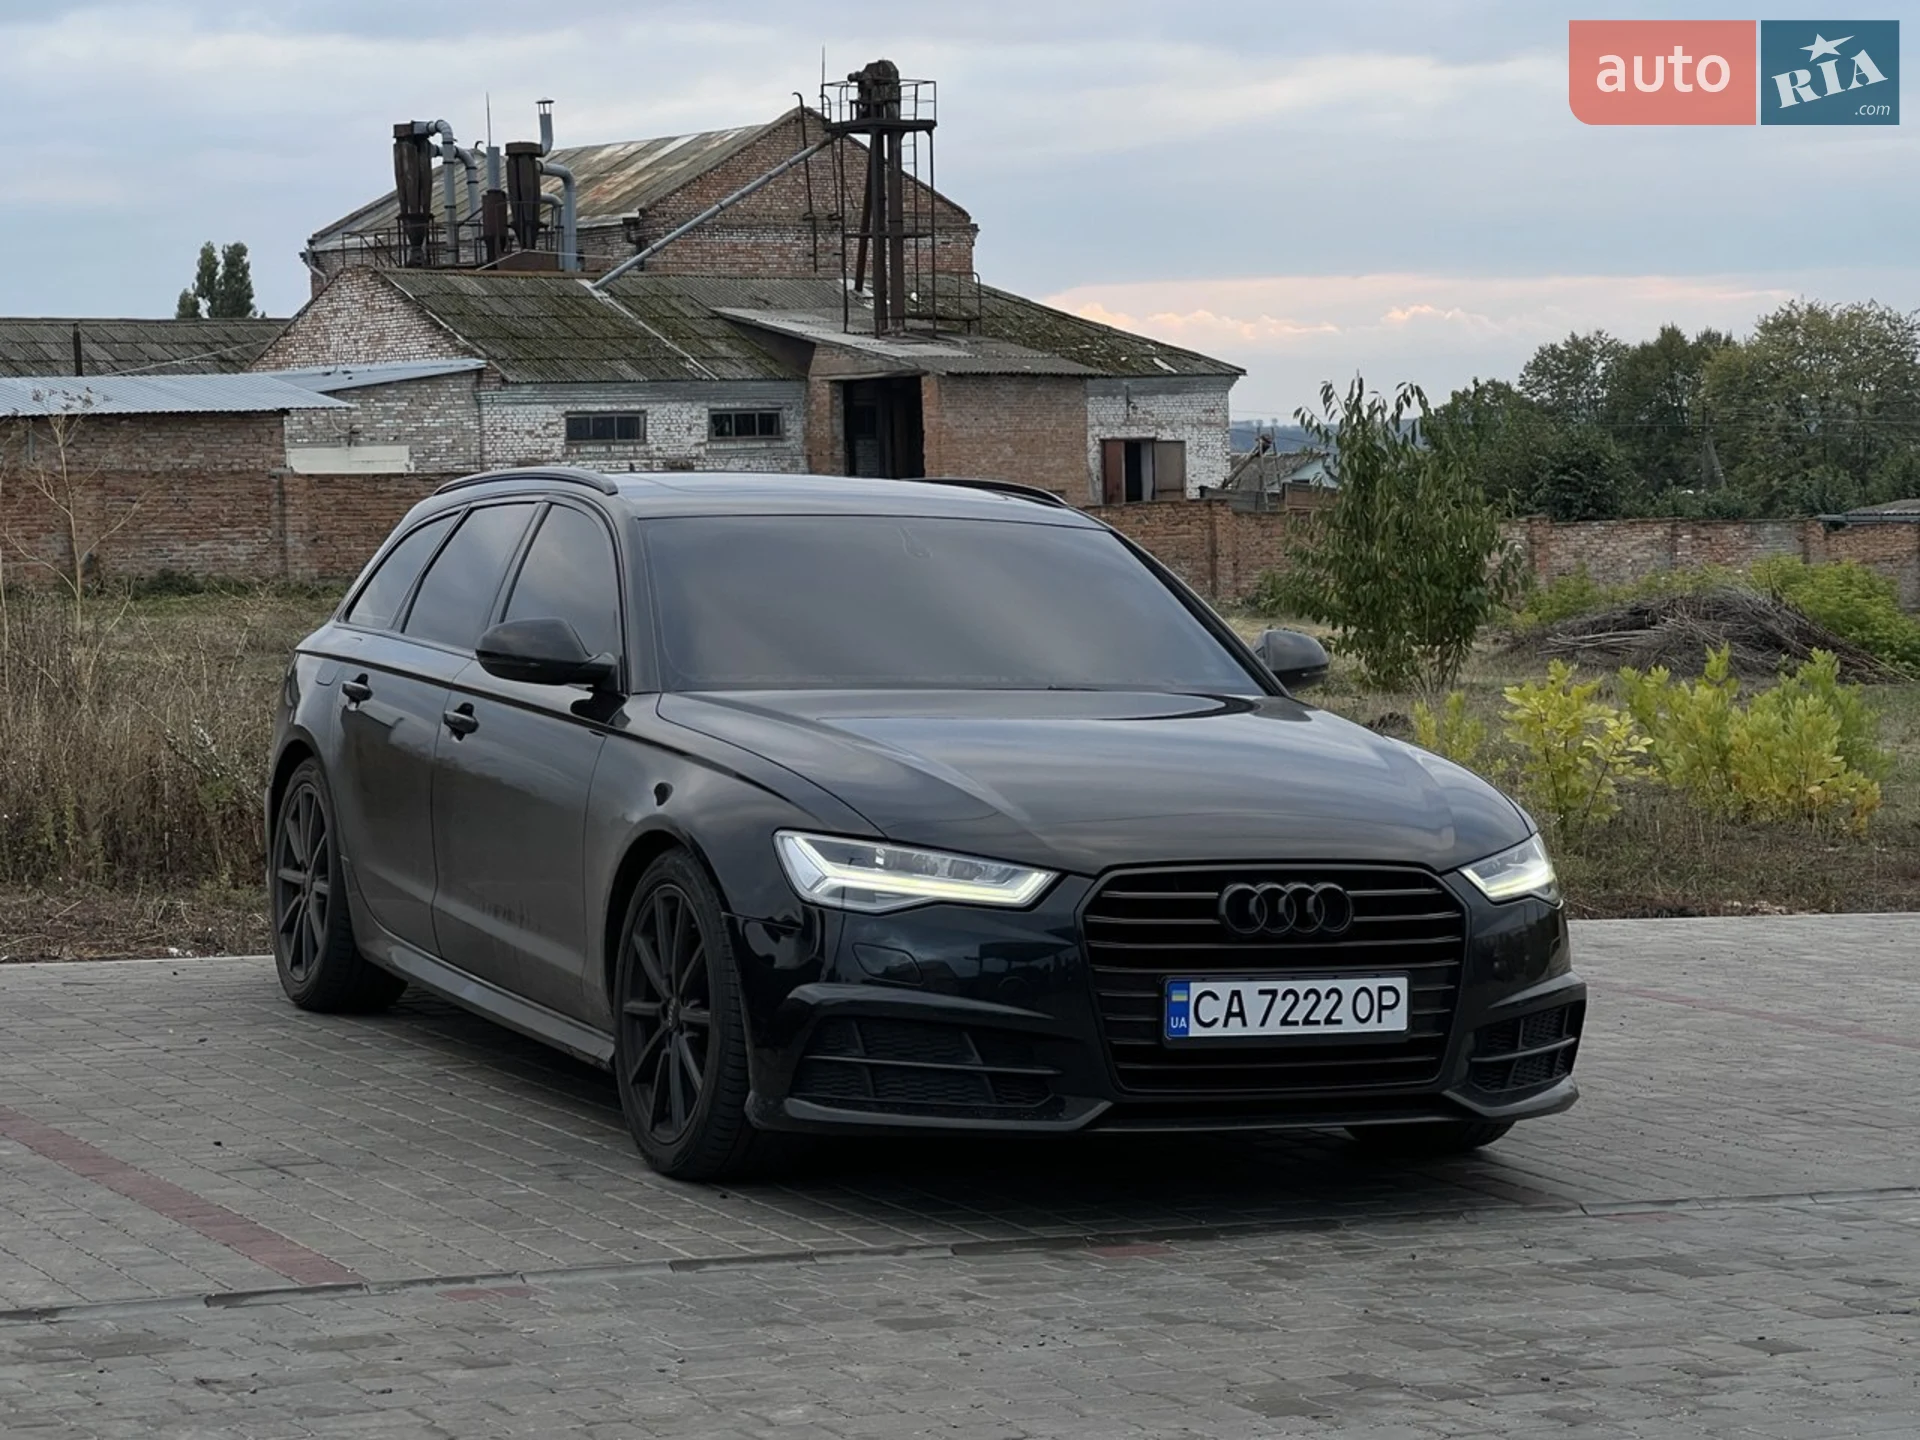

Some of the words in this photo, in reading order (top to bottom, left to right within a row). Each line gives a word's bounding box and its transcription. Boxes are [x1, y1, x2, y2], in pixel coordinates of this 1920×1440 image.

[1193, 989, 1248, 1028] CA
[1257, 987, 1343, 1027] 7222
[1352, 985, 1401, 1024] OP
[1170, 1017, 1187, 1029] UA
